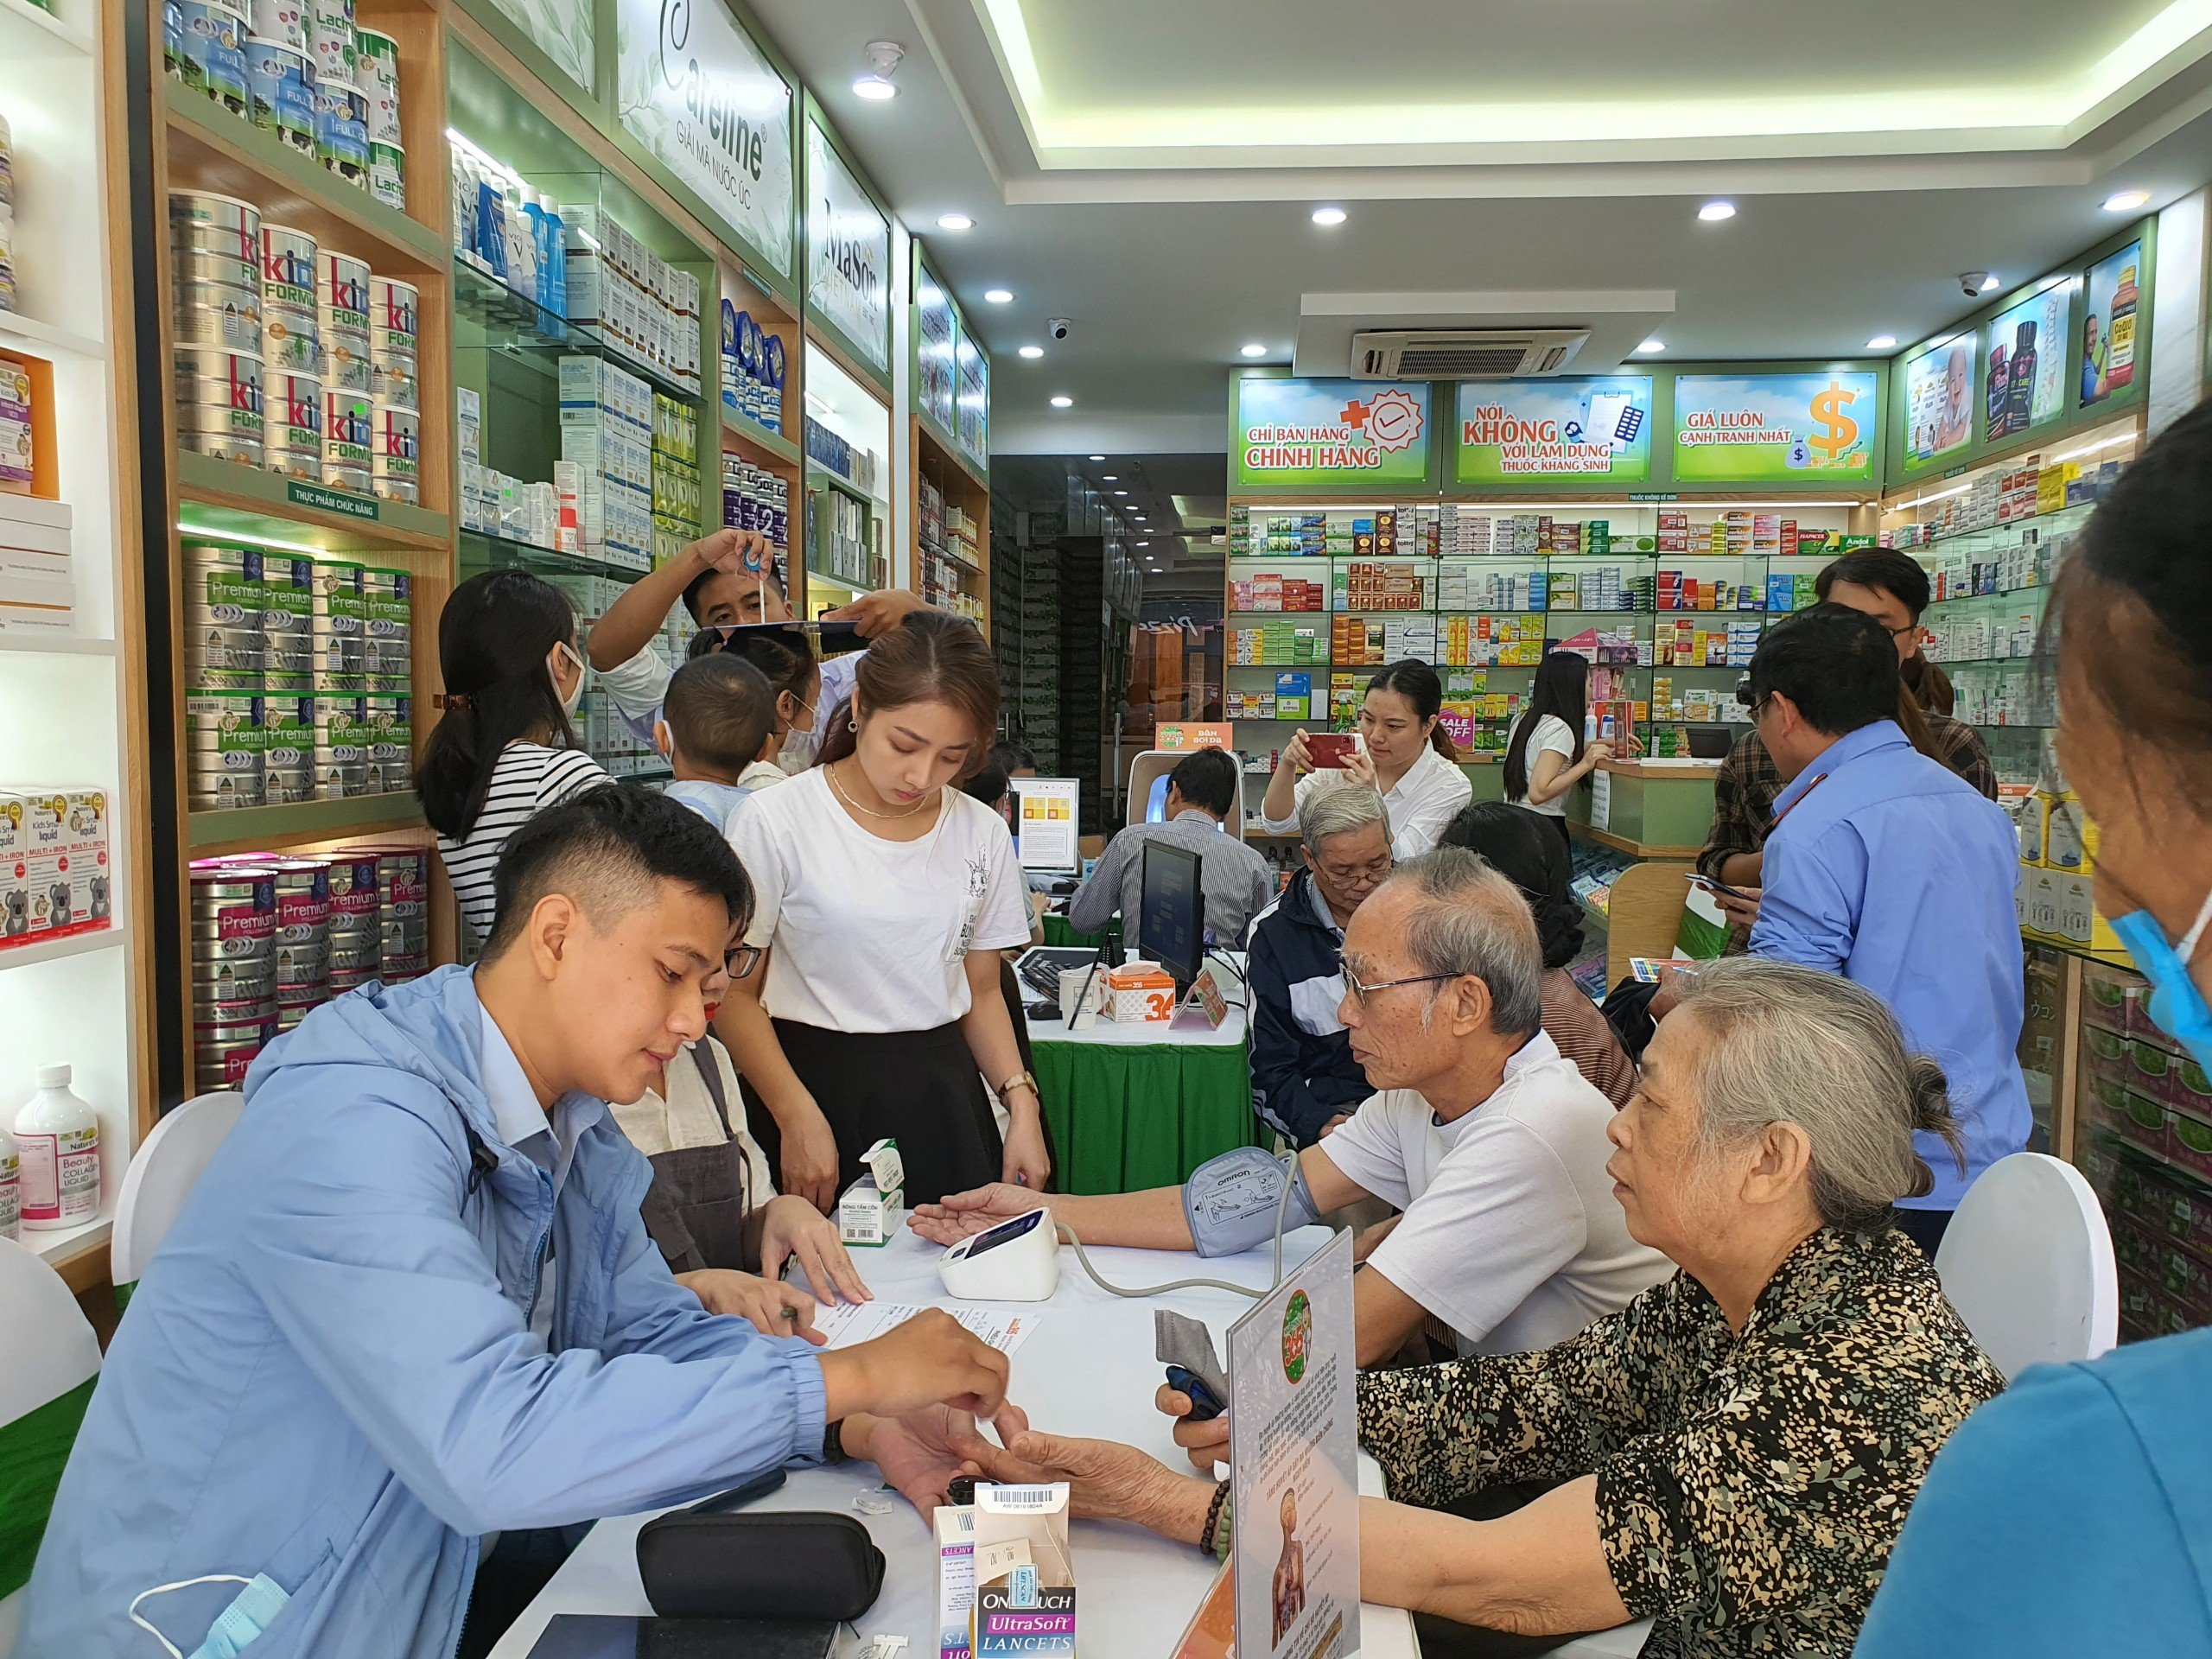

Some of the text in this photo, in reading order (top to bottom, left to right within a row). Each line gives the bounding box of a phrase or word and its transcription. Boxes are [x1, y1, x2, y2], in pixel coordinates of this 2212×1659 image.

[738, 181, 751, 210] ÚC
[1476, 403, 1503, 420] NÓI
[1688, 408, 1764, 427] GIÁ LUÔN
[1249, 423, 1350, 442] CHỈ BÁN HÀNG
[1464, 414, 1556, 444] KHÔNG
[1680, 426, 1791, 448] CẠNH TRANH NHẤT
[1247, 443, 1379, 467] CHÍNH HÃNG
[1502, 458, 1609, 471] THUỐC KHÁNG SINH
[296, 489, 315, 505] THỰC
[315, 492, 335, 508] PHẨM
[336, 497, 354, 514] CHỨC
[1846, 537, 1869, 546] Andol
[1440, 718, 1469, 727] SALE
[33, 820, 45, 829] Kids
[39, 829, 58, 842] liquid
[29, 848, 48, 856] MULTI
[54, 844, 67, 853] IRON
[71, 842, 88, 851] MULTI
[10, 850, 24, 859] IRON
[63, 1155, 94, 1169] Beauty
[64, 1174, 88, 1187] LIQUID
[991, 1616, 1068, 1631] UltraSoft
[983, 1636, 1071, 1651] LANCETS
